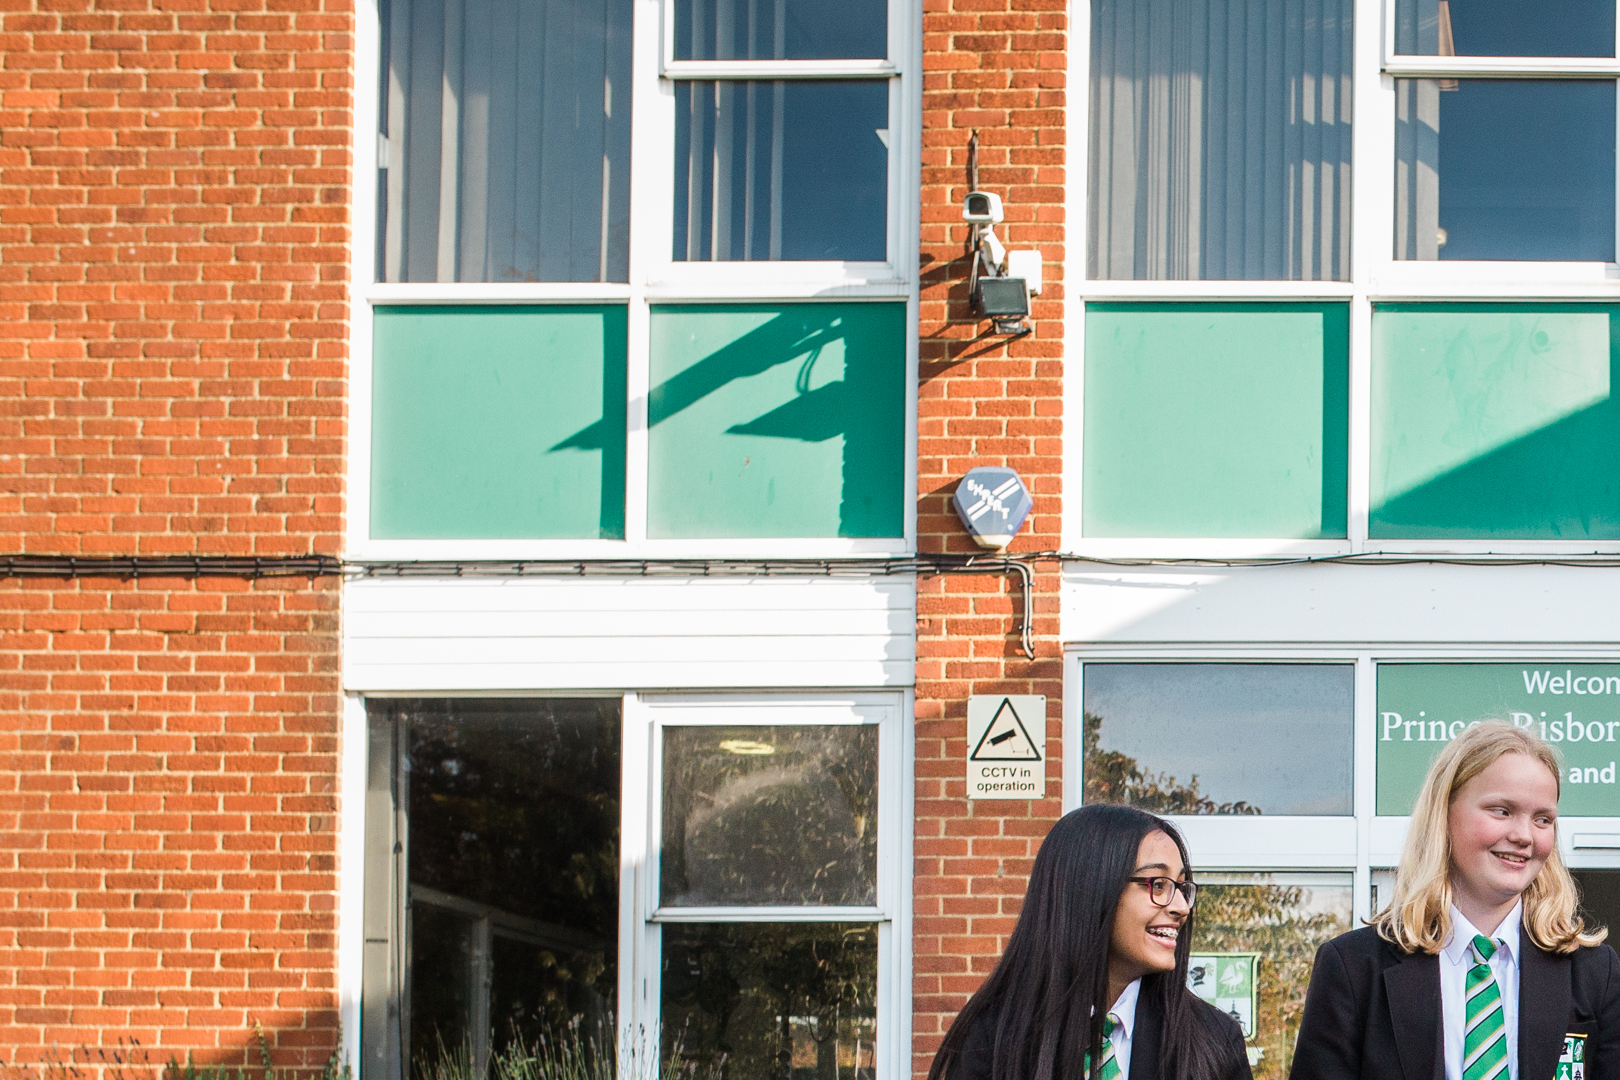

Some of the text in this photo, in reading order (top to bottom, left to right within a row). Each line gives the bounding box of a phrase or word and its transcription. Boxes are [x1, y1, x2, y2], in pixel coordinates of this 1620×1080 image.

[1379, 711, 1482, 742] Princ
[981, 767, 1031, 778] CCTV in
[1568, 761, 1616, 785] and
[976, 780, 1036, 793] operation
